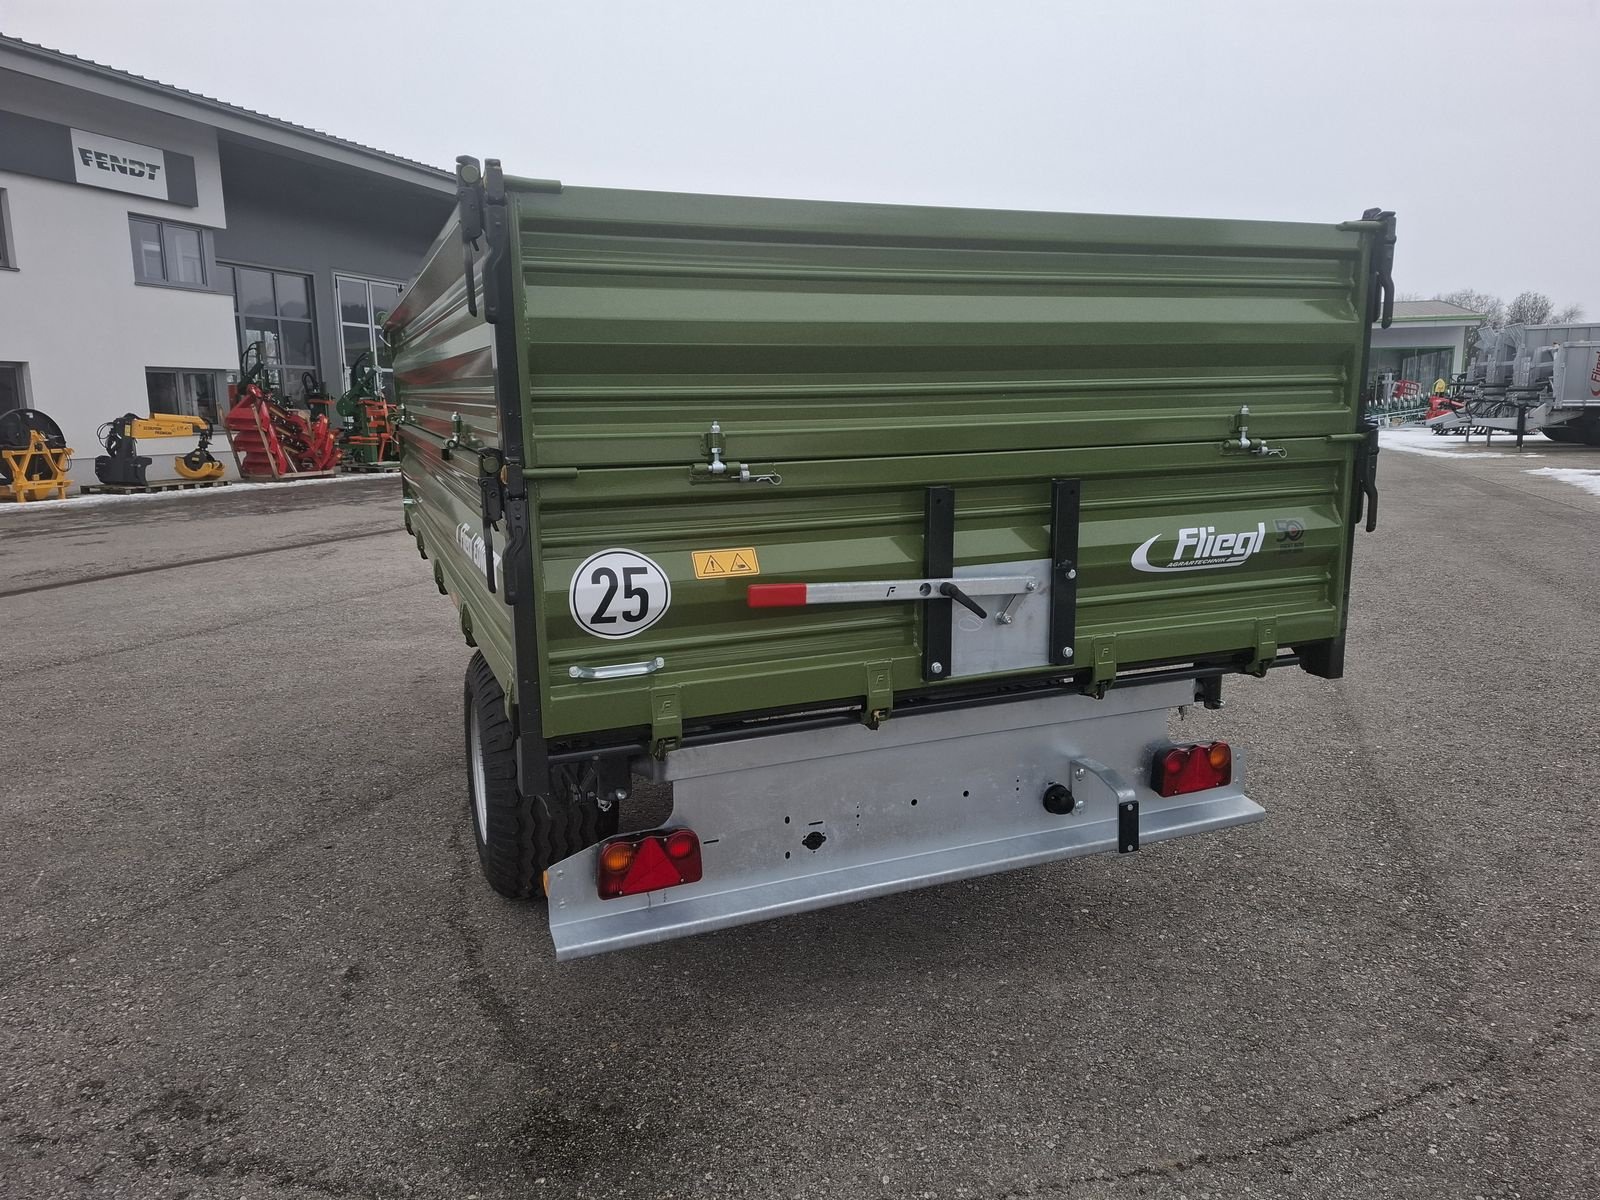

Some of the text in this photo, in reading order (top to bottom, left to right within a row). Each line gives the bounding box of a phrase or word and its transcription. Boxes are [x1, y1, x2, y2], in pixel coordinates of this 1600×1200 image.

[78, 147, 160, 180] FENDT
[1173, 522, 1265, 561] Fliegl
[1167, 557, 1228, 568] AGRARTECHNIK
[590, 567, 649, 624] 25
[886, 586, 896, 597] F
